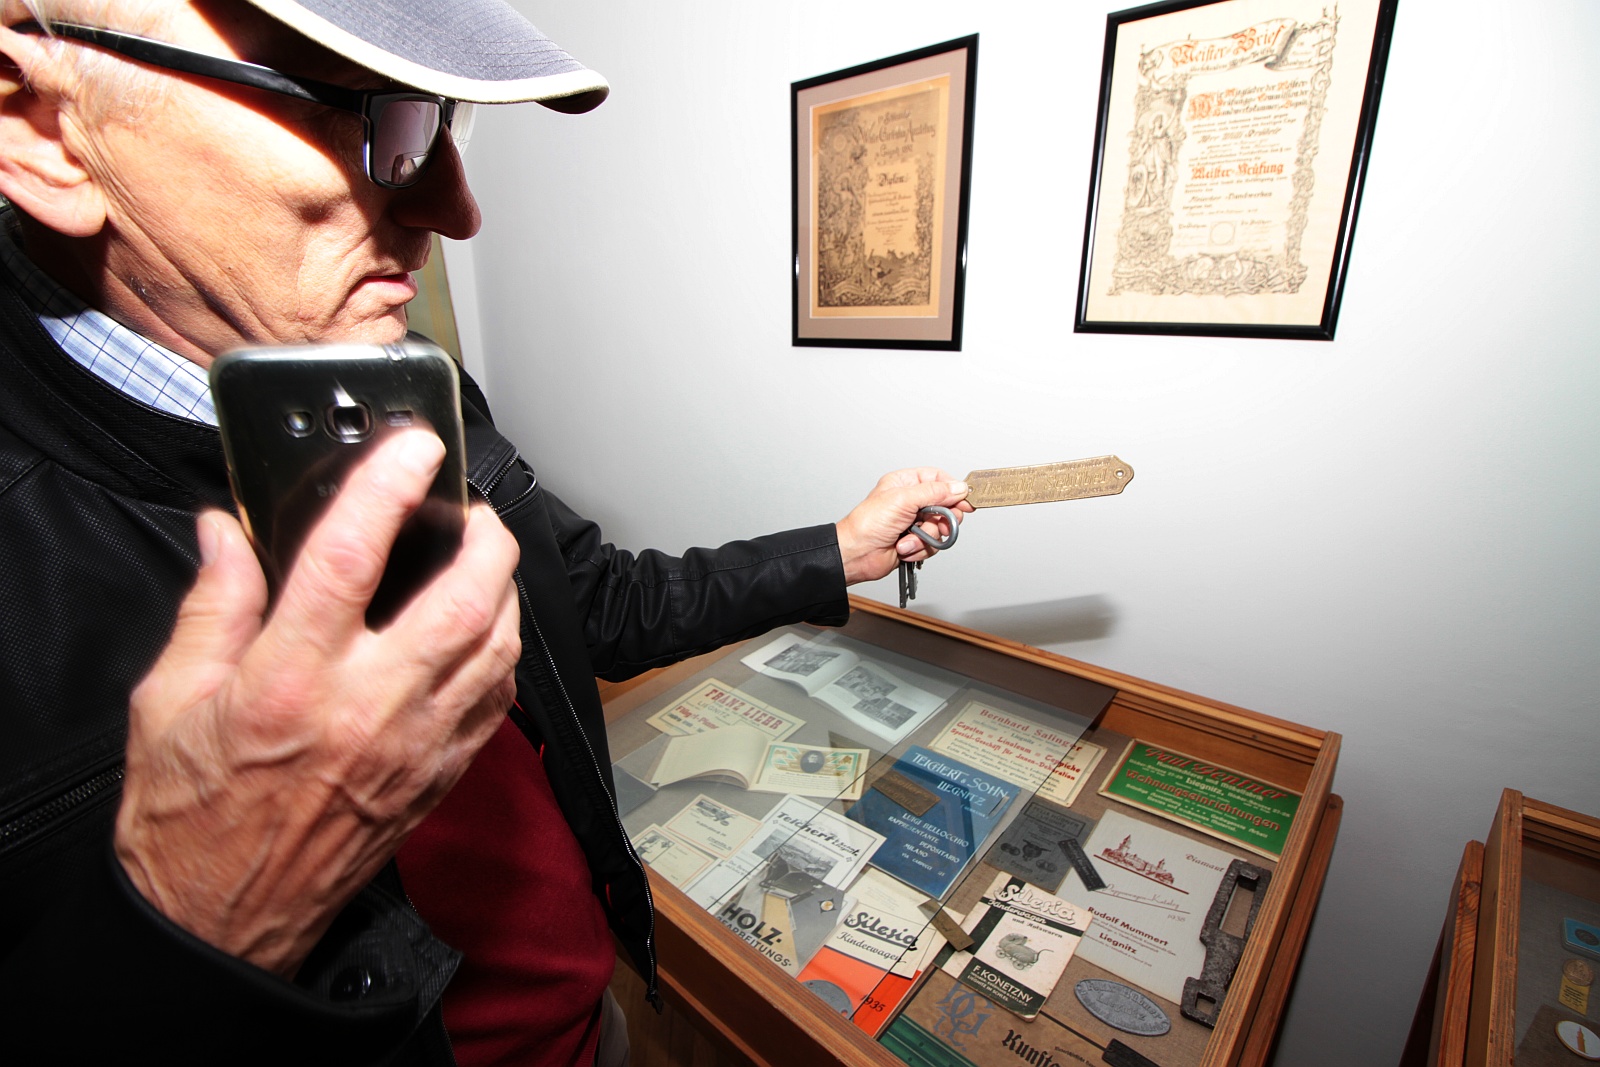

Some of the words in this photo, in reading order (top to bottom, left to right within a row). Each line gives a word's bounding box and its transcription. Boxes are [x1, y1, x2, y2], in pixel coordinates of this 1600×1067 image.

[705, 688, 746, 712] FRANZ
[743, 705, 784, 730] LIEHR
[979, 708, 1031, 732] Bernhard
[1033, 728, 1083, 752] Salinger
[1145, 746, 1191, 769] Paul
[937, 780, 986, 806] LIEGNITZ
[967, 777, 1009, 798] SOHN
[1125, 768, 1281, 832] Wohnungseinrichtungen
[902, 812, 923, 826] LUIGI
[922, 822, 969, 848] BELLOCCHIO
[903, 843, 929, 858] MILANO
[1185, 853, 1226, 873] Diamant
[843, 911, 918, 951] Silesia
[1087, 906, 1120, 924] Rudolf
[1120, 920, 1169, 947] Mummert
[1099, 931, 1137, 955] Liegnitz
[836, 930, 907, 964] Kinderwagen
[980, 969, 1034, 1003] KONETZNY
[861, 994, 886, 1013] 1935
